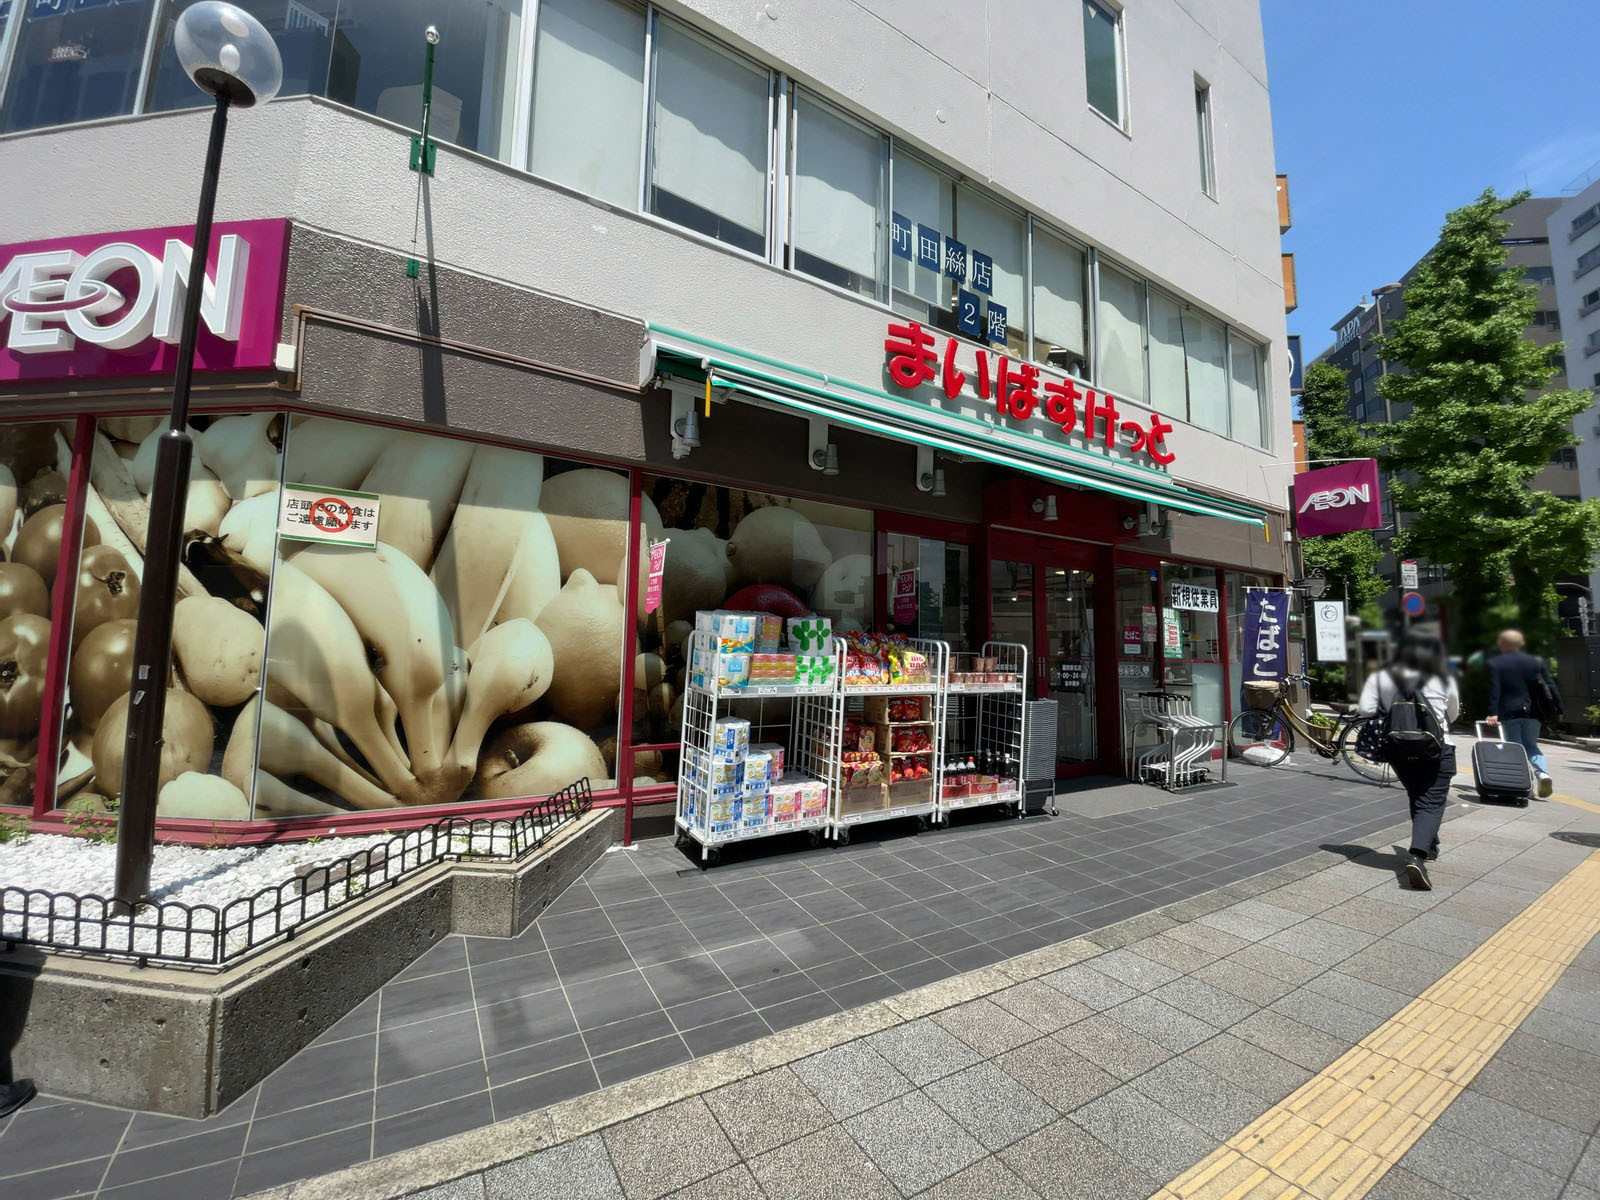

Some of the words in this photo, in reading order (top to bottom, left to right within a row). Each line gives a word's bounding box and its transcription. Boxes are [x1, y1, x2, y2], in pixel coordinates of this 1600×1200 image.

[963, 301, 1007, 342] 2階
[884, 321, 1176, 465] まいばすけっと
[287, 498, 375, 518] 店頭での飲食は
[1298, 483, 1371, 514] AEON
[287, 512, 374, 531] ご遠慮願います
[1253, 597, 1281, 677] たばこ
